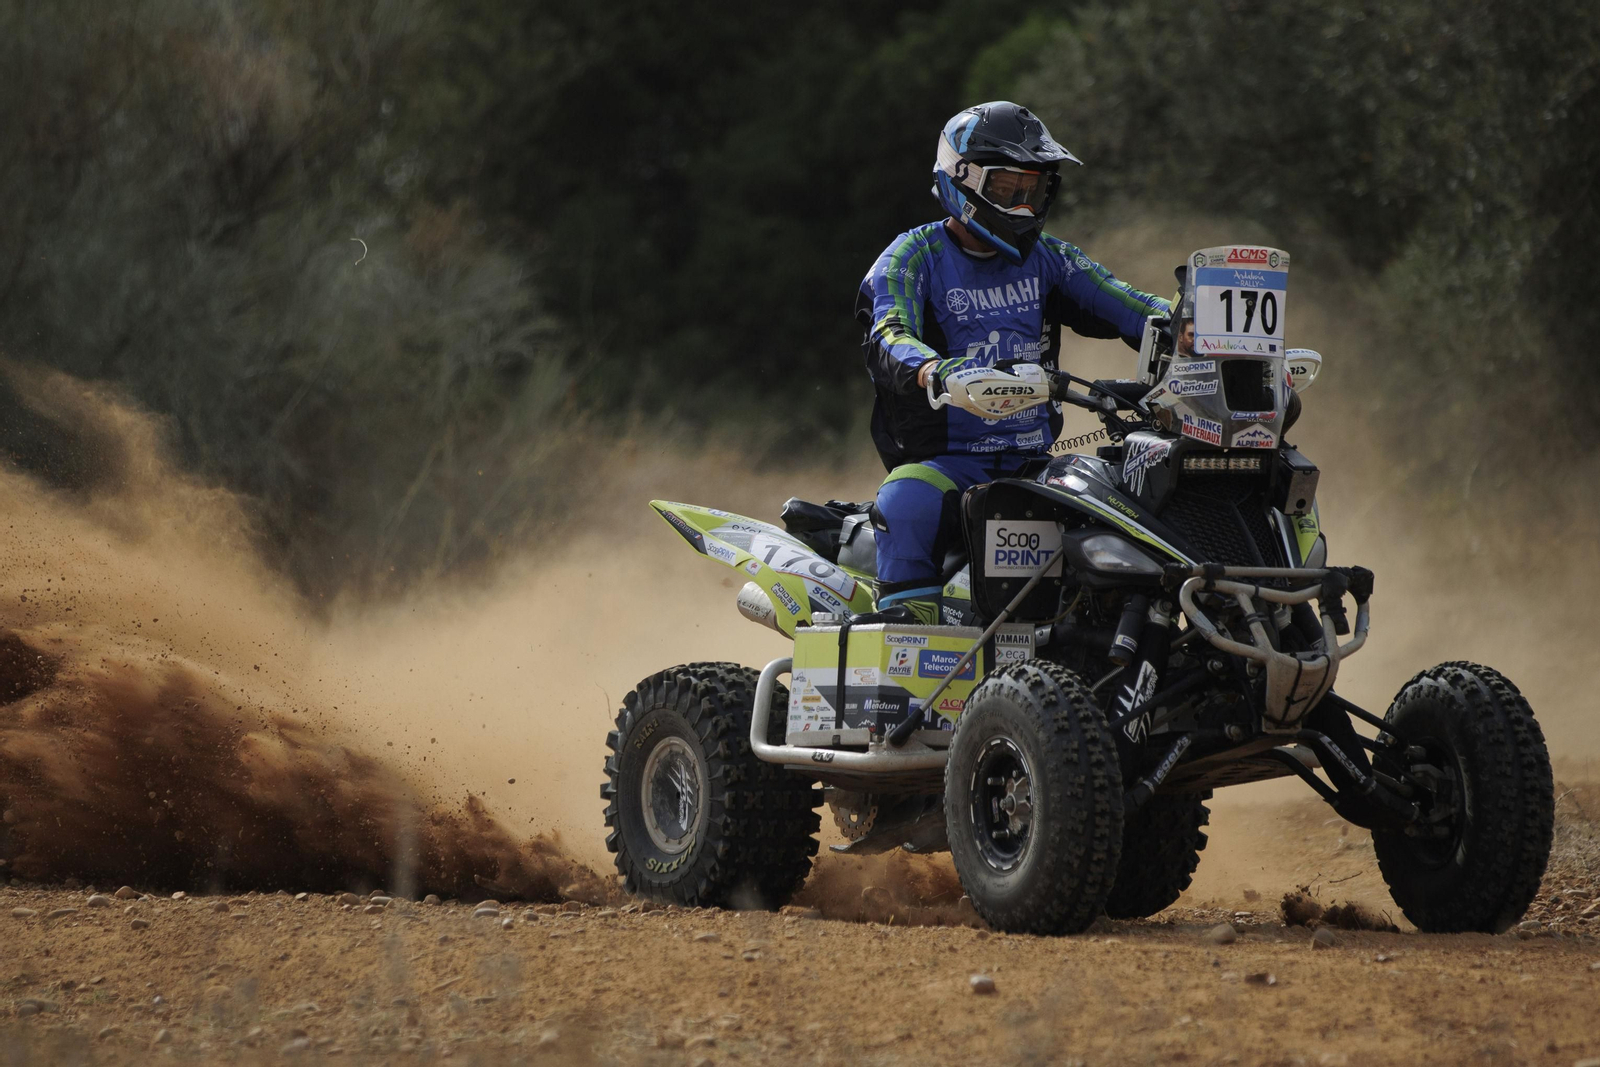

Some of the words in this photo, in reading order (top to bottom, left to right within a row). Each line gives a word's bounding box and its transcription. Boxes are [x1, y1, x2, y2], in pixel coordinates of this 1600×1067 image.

[1228, 248, 1268, 259] ACMS
[957, 303, 1040, 322] RACING
[1220, 289, 1277, 335] 170
[982, 386, 1035, 396] ACERBIS
[1170, 381, 1217, 394] Menduni
[1182, 423, 1220, 445] MATERIAUX
[1235, 440, 1273, 448] ALPESMAT
[763, 544, 836, 579] 170
[994, 550, 1055, 566] PRINT
[812, 586, 841, 607] SCEP
[995, 634, 1030, 645] YAMAHA
[931, 655, 958, 663] Maroc
[1006, 650, 1026, 660] eca
